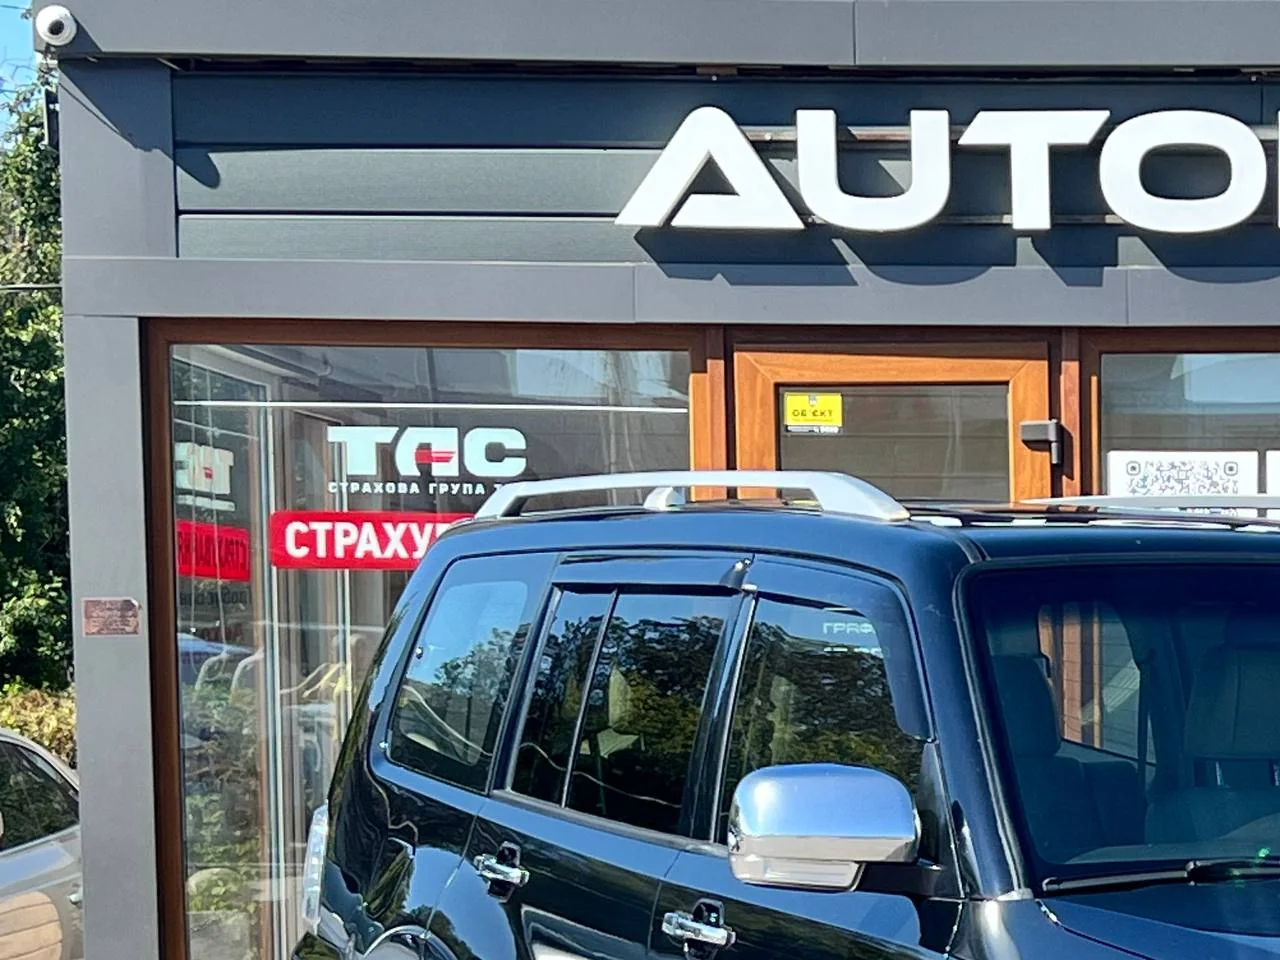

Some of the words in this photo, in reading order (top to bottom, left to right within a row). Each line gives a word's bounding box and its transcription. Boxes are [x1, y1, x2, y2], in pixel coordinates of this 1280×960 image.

[327, 482, 420, 494] СТРАХОВА
[428, 482, 486, 494] ГРУПА
[284, 521, 450, 558] СТРАХУ
